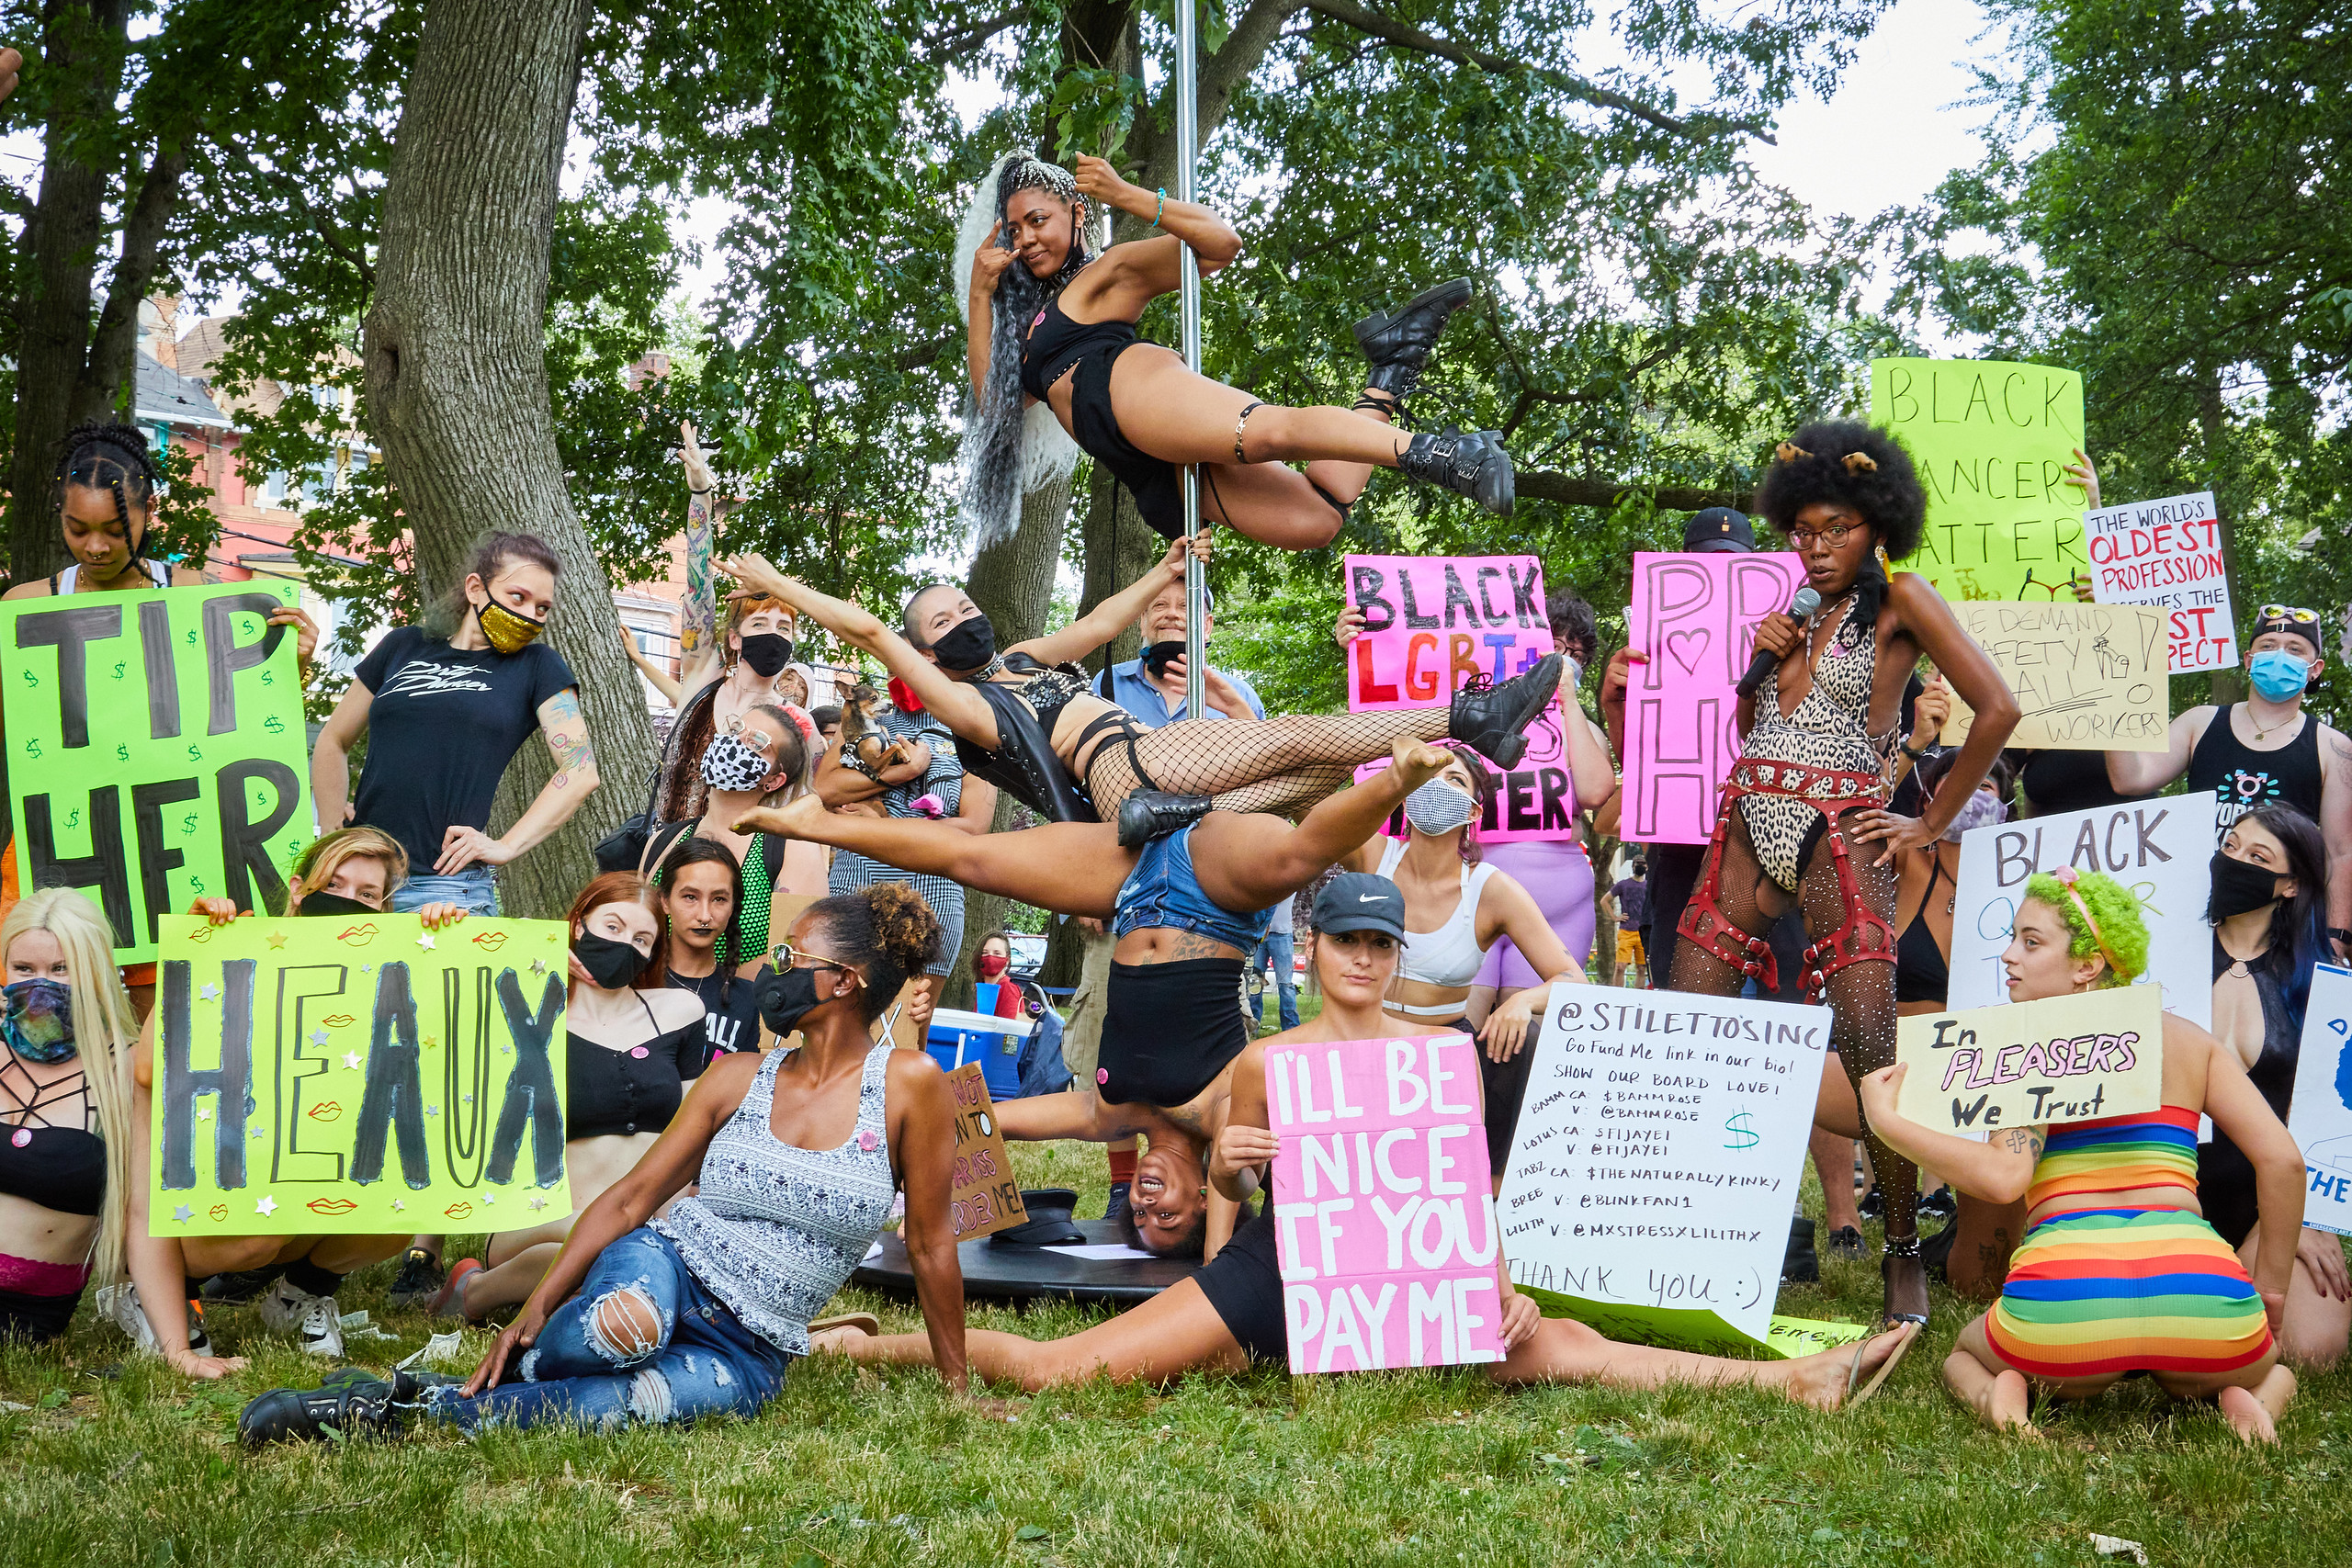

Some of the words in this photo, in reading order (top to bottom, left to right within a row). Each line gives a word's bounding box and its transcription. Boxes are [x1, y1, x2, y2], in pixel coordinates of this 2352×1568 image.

[1889, 367, 2078, 442] BLACK
[1918, 457, 2086, 512] ANCERS
[2091, 512, 2129, 534] THE
[2136, 501, 2205, 527] WORLD'S
[1905, 517, 2086, 568] ATTER
[2090, 518, 2218, 565] OLDEST
[2101, 548, 2224, 593] PROFESSION
[1352, 563, 1550, 632] BLACK
[2188, 588, 2224, 605] THE
[1998, 607, 2113, 636] DEMAND
[2168, 607, 2215, 640] ST
[16, 593, 285, 749] TIP
[1981, 638, 2081, 671] AFETY
[2168, 637, 2230, 671] PECT
[2012, 670, 2104, 707] ALL
[2045, 712, 2163, 743] WORKERS
[23, 758, 300, 949] HER
[1995, 808, 2173, 887] BLACK
[1566, 1037, 1585, 1054] Go
[1590, 1041, 1624, 1056] Fund
[1630, 1043, 1654, 1060] Me
[1666, 1045, 1697, 1060] link
[1705, 1047, 1719, 1062] in
[1725, 1055, 1754, 1066] our
[1930, 1020, 1976, 1048] In
[160, 958, 568, 1191] HEAUX
[1272, 1049, 1363, 1125] I'LL
[1385, 1035, 1473, 1116] BE
[1554, 1065, 1593, 1079] SHOW
[1608, 1070, 1640, 1084] OUR
[1653, 1073, 1709, 1089] BOARD
[1940, 1031, 2140, 1091] PLEASERS
[1531, 1090, 1565, 1114] BAMM
[1600, 1105, 1700, 1122] @BAMMROSE
[1951, 1093, 2002, 1128] We
[2026, 1083, 2105, 1120] Trust
[1300, 1123, 1470, 1198] NICE
[1523, 1126, 1557, 1150] LOTUS
[953, 1149, 997, 1190] ARASS
[1510, 1187, 1544, 1208] BREE
[1580, 1194, 1692, 1208] @BLINKFAN1
[1274, 1197, 1354, 1281] IF
[1370, 1193, 1499, 1269] YOU
[1506, 1258, 1625, 1299] THANK
[1648, 1269, 1719, 1307] YOU
[1284, 1282, 1398, 1375] PAY
